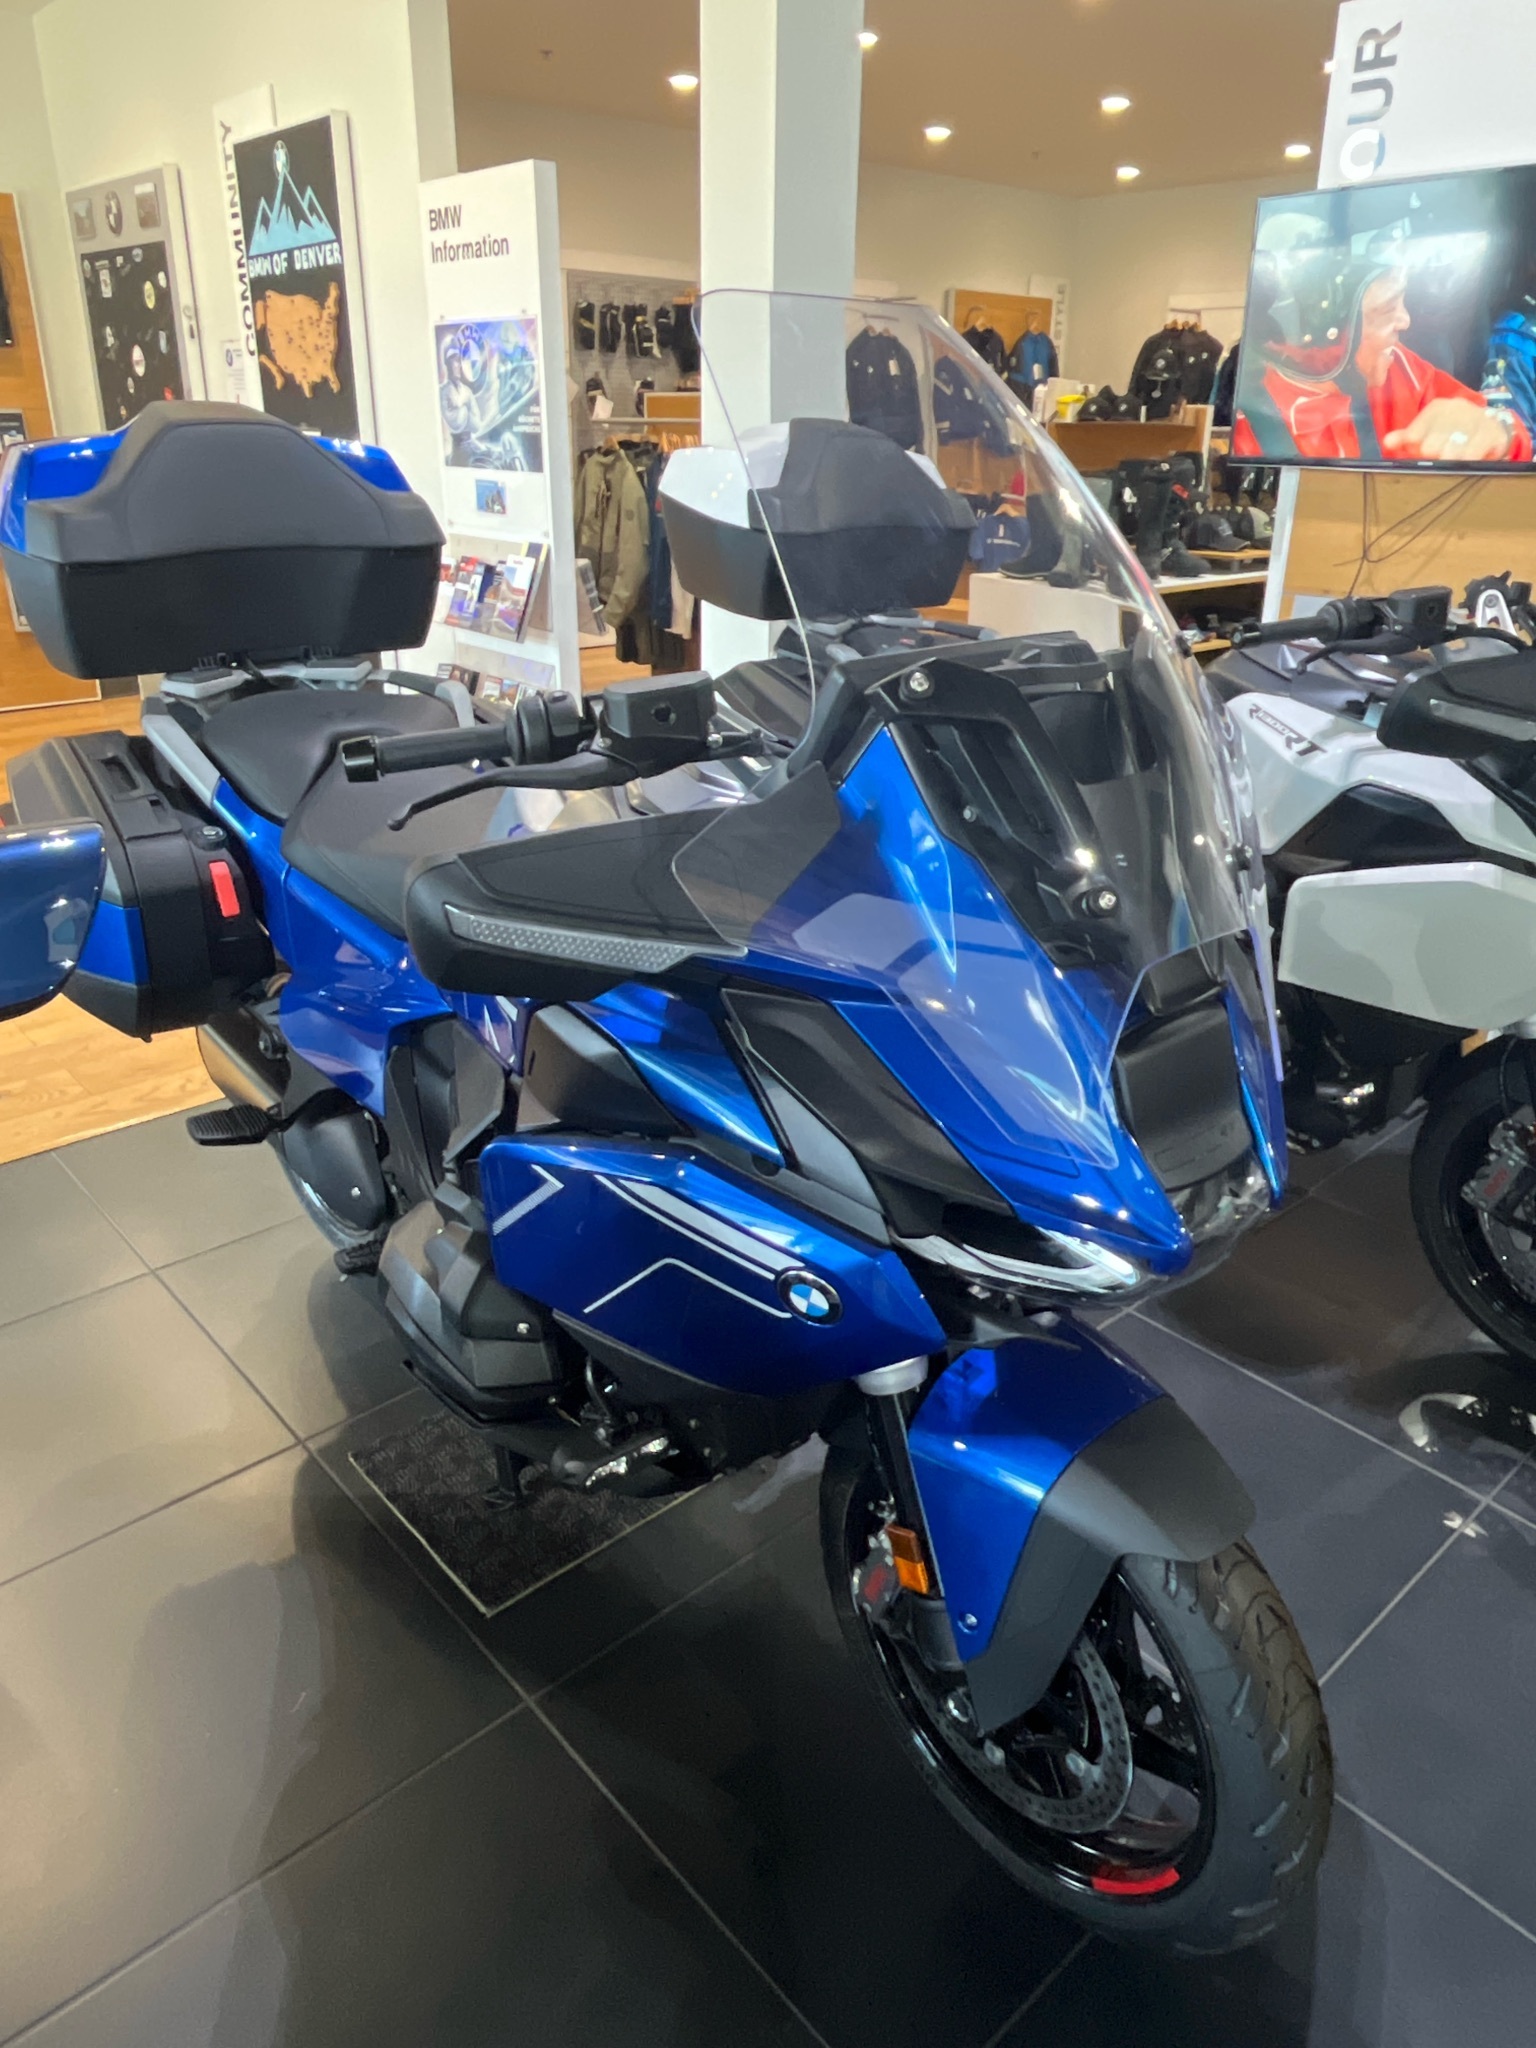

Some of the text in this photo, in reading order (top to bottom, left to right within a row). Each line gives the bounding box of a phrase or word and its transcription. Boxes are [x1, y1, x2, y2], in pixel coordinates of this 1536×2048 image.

[428, 203, 463, 232] BMW
[248, 241, 343, 278] BMW OF DENVER
[430, 233, 510, 264] Information
